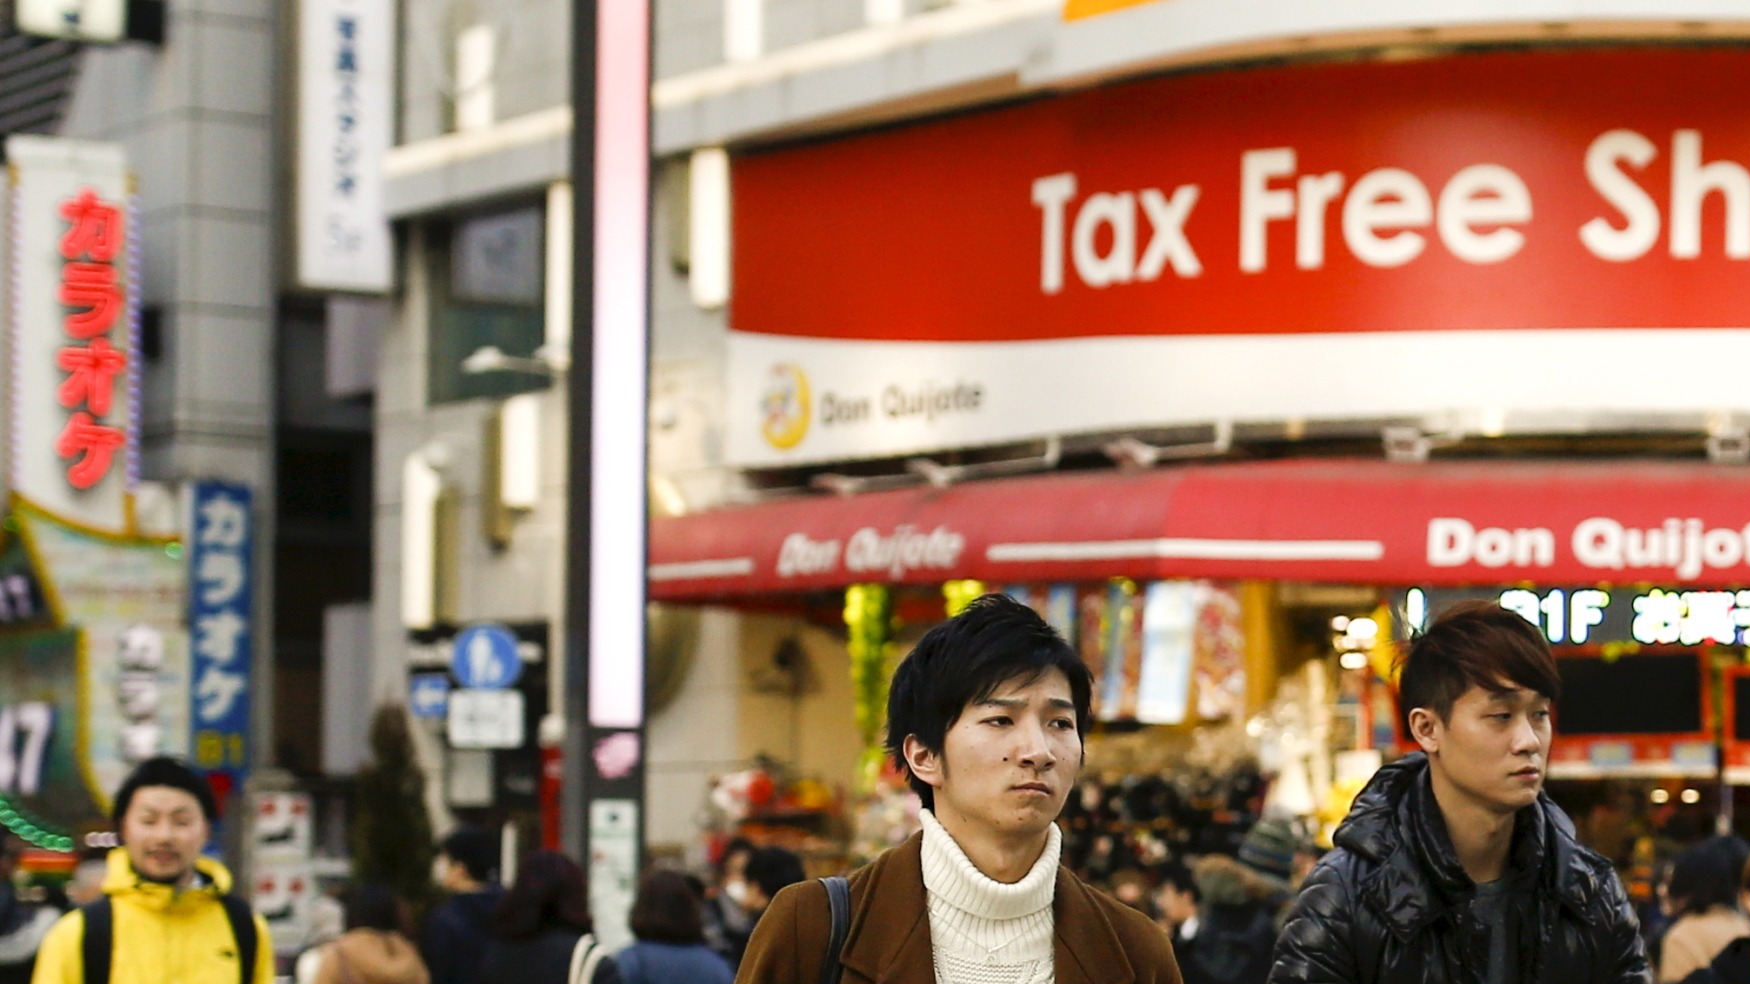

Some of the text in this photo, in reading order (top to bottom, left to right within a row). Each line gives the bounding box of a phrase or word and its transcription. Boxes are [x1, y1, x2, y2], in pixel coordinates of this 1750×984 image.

[1031, 172, 1203, 295] Tax
[1239, 147, 1533, 273] Free
[57, 187, 126, 490] カラオケ
[819, 379, 985, 426] Don Quijote
[777, 523, 963, 580] Don Quijote
[1426, 517, 1556, 568] Don
[198, 496, 244, 722] カラオケ
